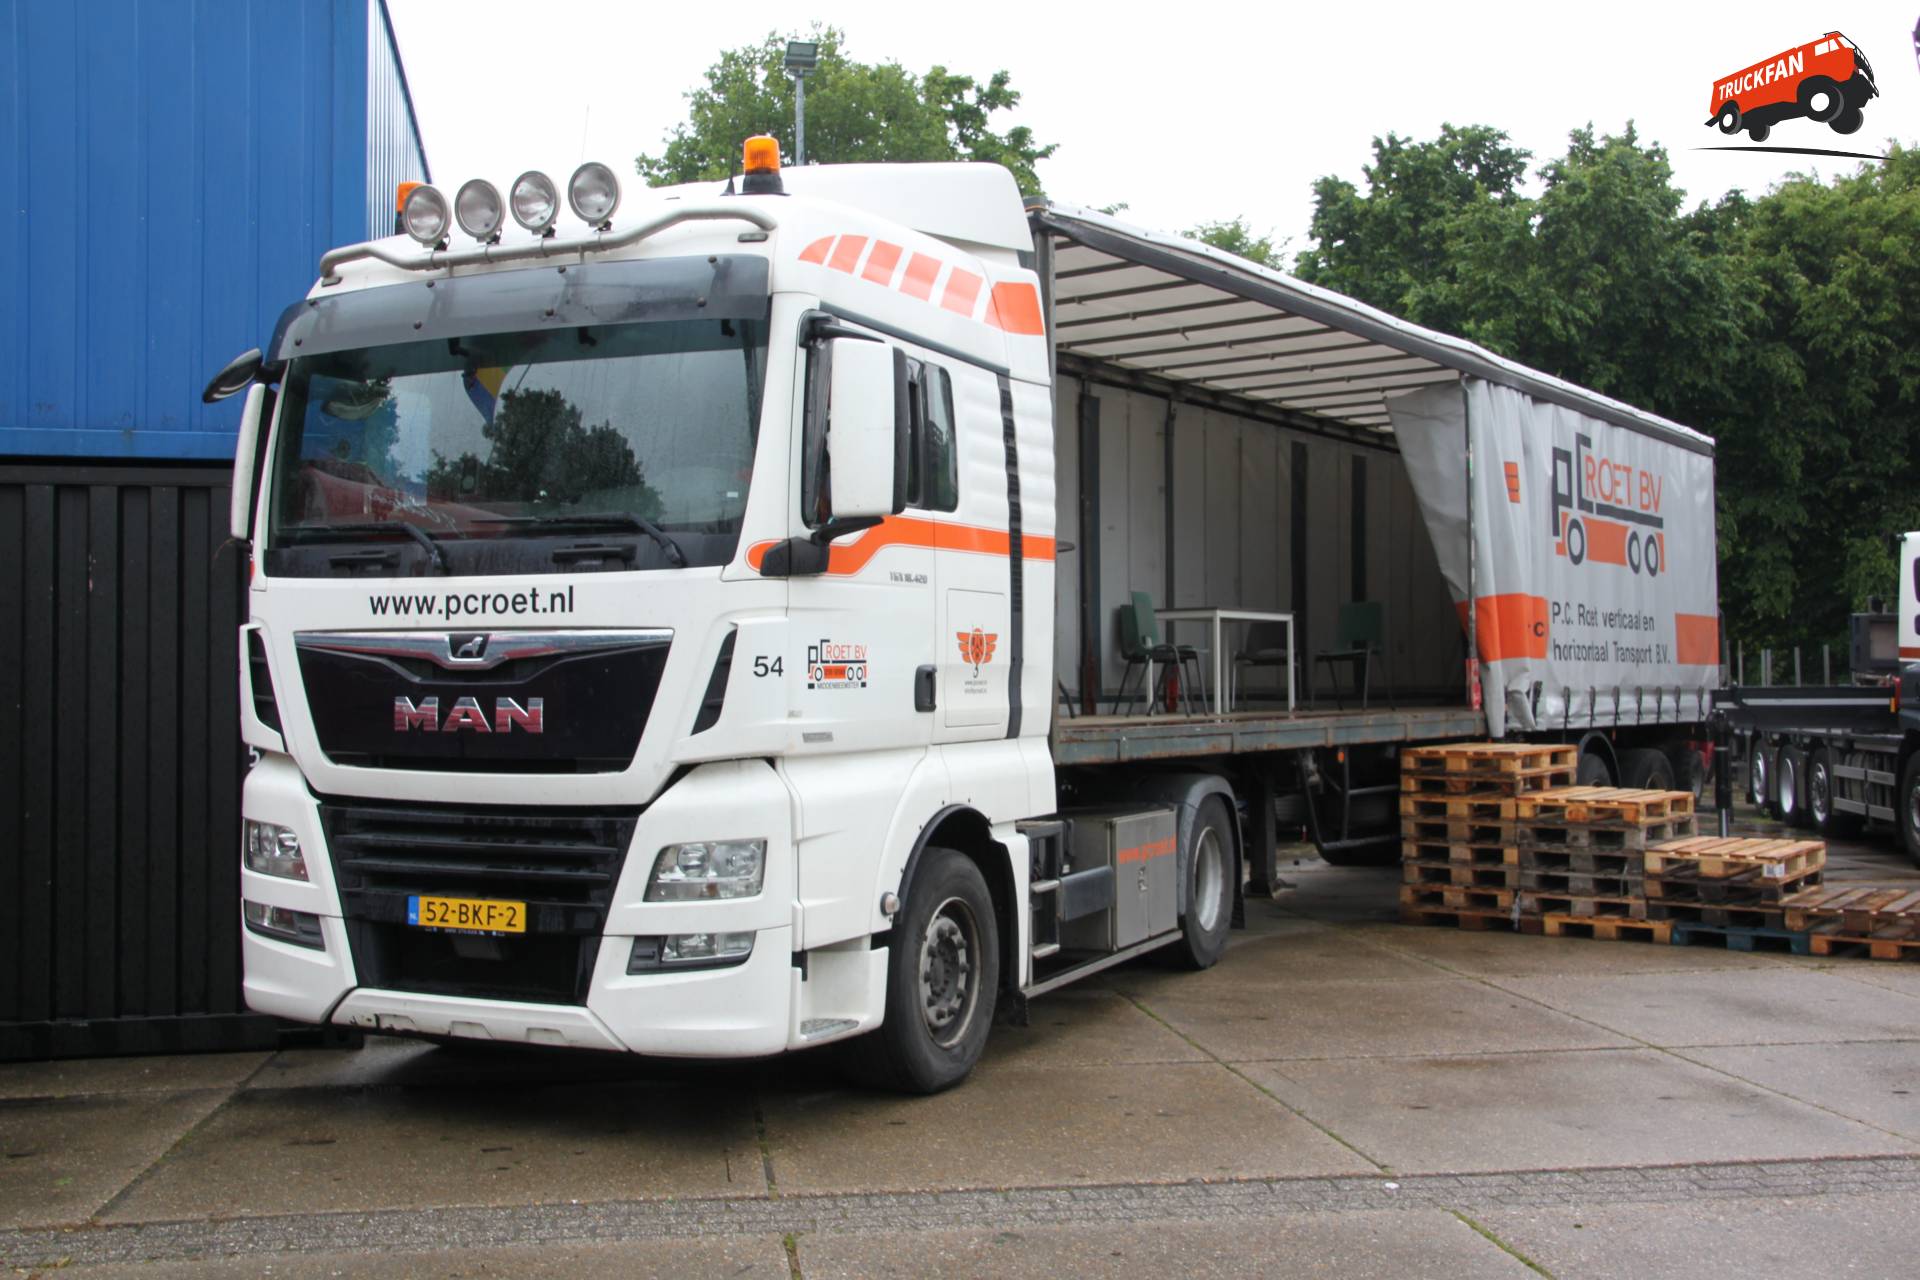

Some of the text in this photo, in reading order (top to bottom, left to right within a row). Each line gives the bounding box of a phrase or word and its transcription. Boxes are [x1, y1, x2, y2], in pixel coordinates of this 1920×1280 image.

[1584, 455, 1632, 506] ROET
[1639, 471, 1662, 513] BV
[369, 585, 574, 620] www.pcroet.nl
[826, 645, 852, 659] ROET
[855, 645, 868, 659] BV
[1613, 641, 1652, 667] Transport
[753, 655, 784, 678] 54
[394, 696, 544, 733] MAN
[425, 901, 517, 927] 52-BKF-2
